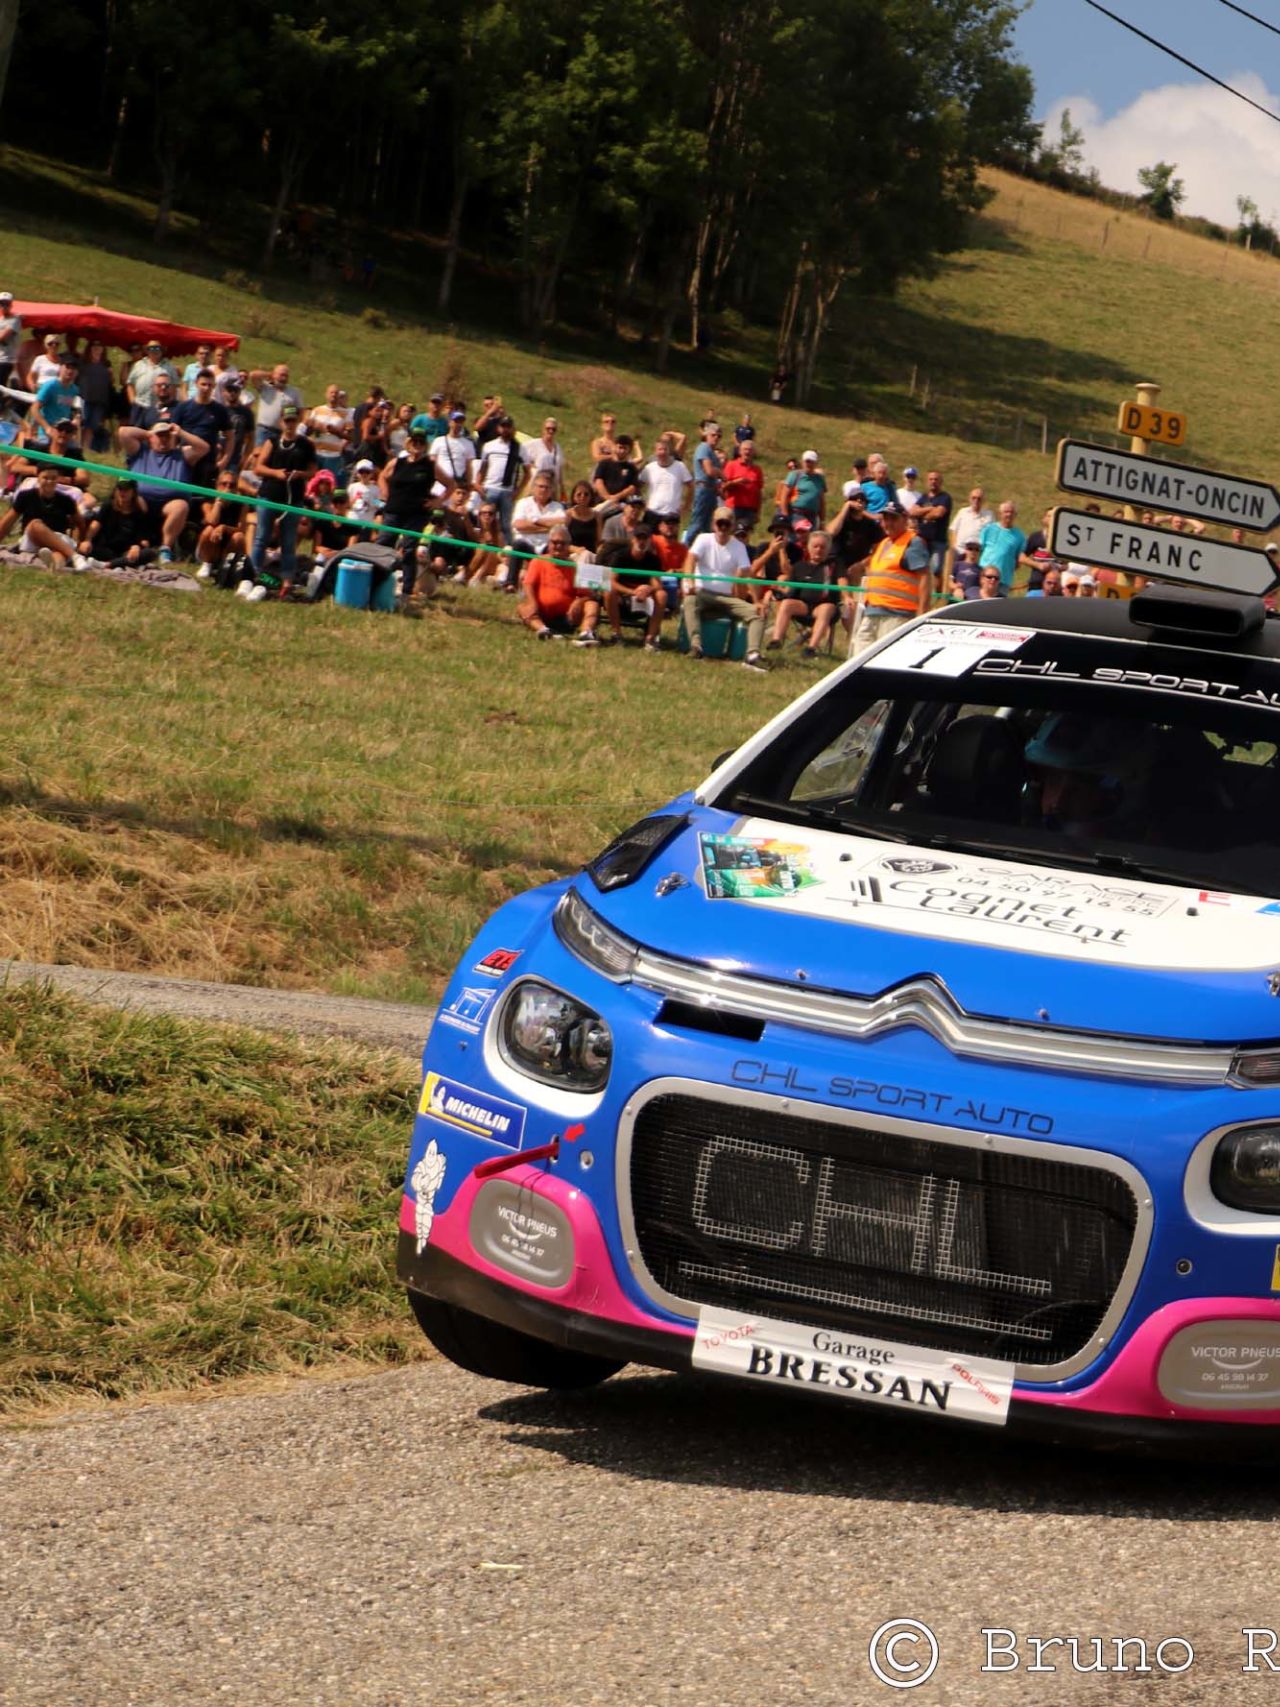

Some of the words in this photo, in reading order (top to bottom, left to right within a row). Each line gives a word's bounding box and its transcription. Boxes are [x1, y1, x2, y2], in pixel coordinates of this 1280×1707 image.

[1127, 407, 1141, 430] D
[1150, 413, 1181, 439] 39
[1073, 457, 1265, 519] ATTIGNAT-ONCIN
[1110, 533, 1203, 571] FRANC
[909, 646, 946, 669] 1
[975, 657, 1080, 679] CHL
[1093, 667, 1248, 697] SPORT
[889, 880, 1084, 919] Cognet
[956, 876, 990, 887] 04
[978, 867, 1168, 903] GARAGE
[919, 895, 1133, 943] Laurent
[446, 1095, 511, 1132] MICHELIN
[731, 1059, 818, 1093] CHL
[829, 1077, 954, 1116] SPORT
[953, 1103, 1055, 1134] AUTO
[498, 1205, 526, 1226] VICTOR
[527, 1218, 557, 1238] PNEUS
[692, 1135, 1052, 1296] CHL
[701, 1322, 755, 1350] TOYOTA
[812, 1331, 896, 1365] Garage
[1190, 1346, 1237, 1358] VICTOR
[746, 1343, 954, 1410] BRESSAN
[1201, 1373, 1216, 1382] 06
